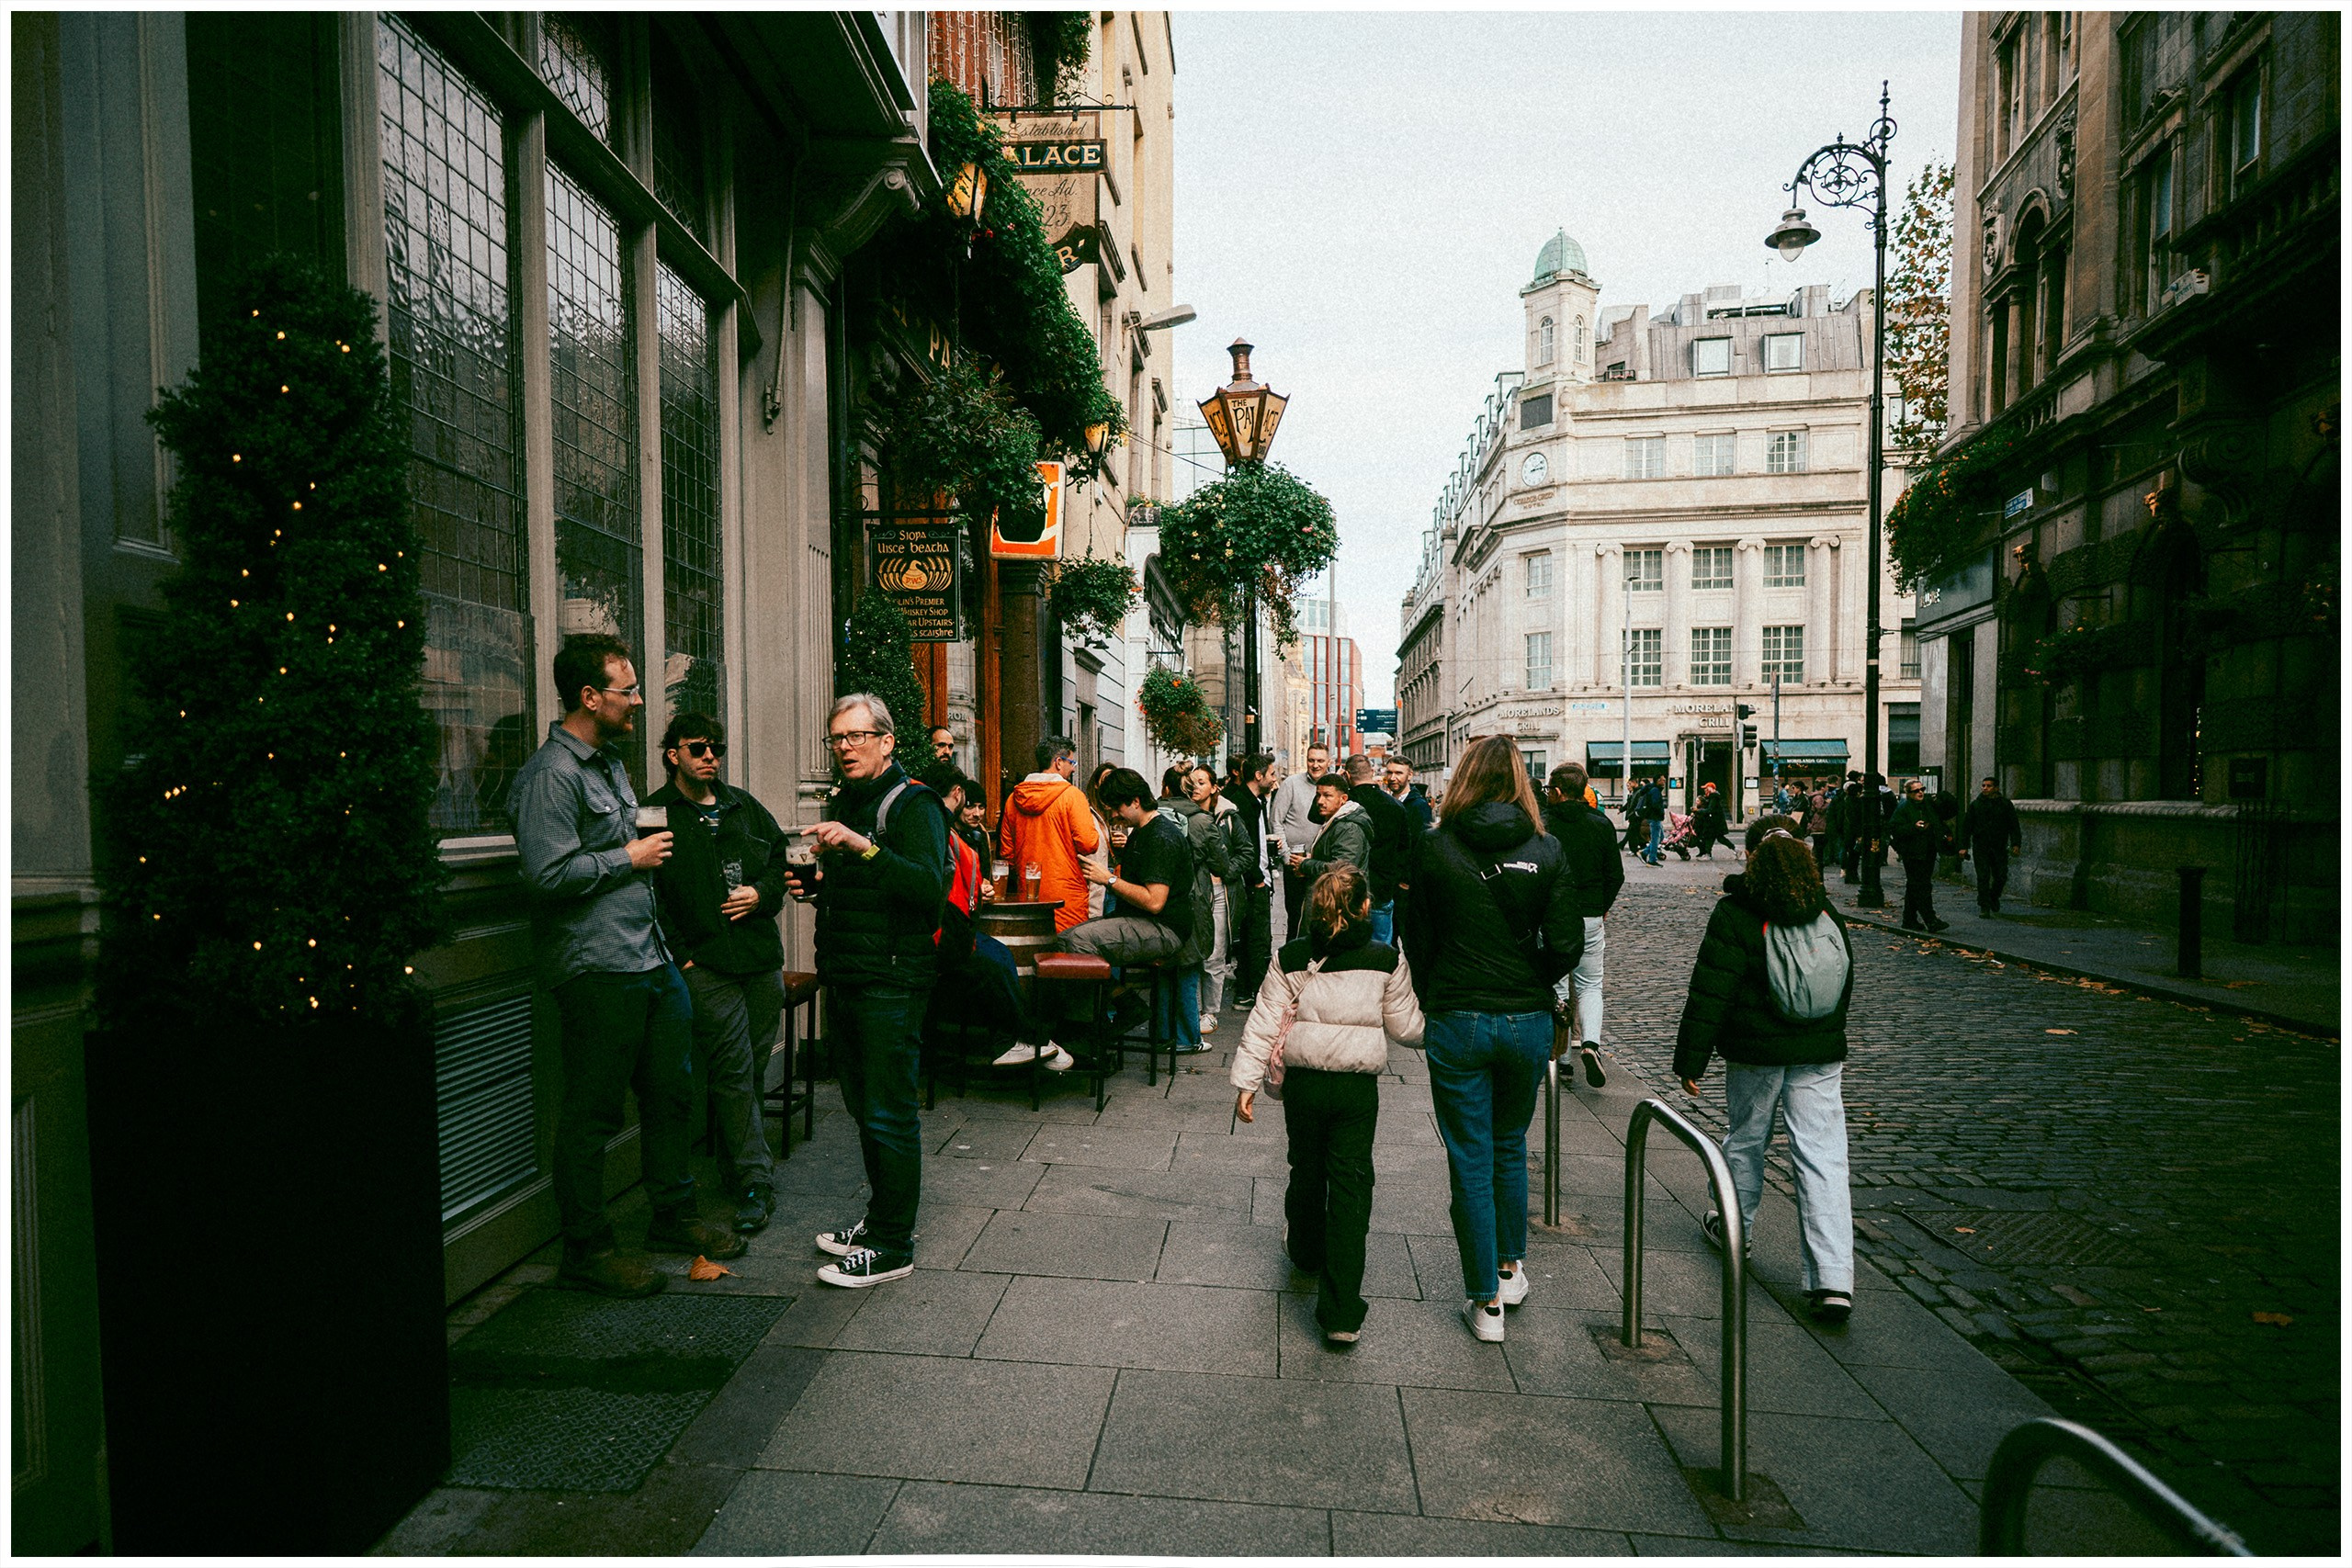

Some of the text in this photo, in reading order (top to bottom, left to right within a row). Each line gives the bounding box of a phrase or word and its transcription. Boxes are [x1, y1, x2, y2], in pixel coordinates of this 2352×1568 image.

[1009, 121, 1088, 139] Established
[1004, 144, 1101, 165] ALACE
[1231, 399, 1248, 407] THE
[1498, 706, 1561, 718] MORELANDS
[1517, 721, 1541, 732] GRILL
[1699, 716, 1730, 728] GRILL
